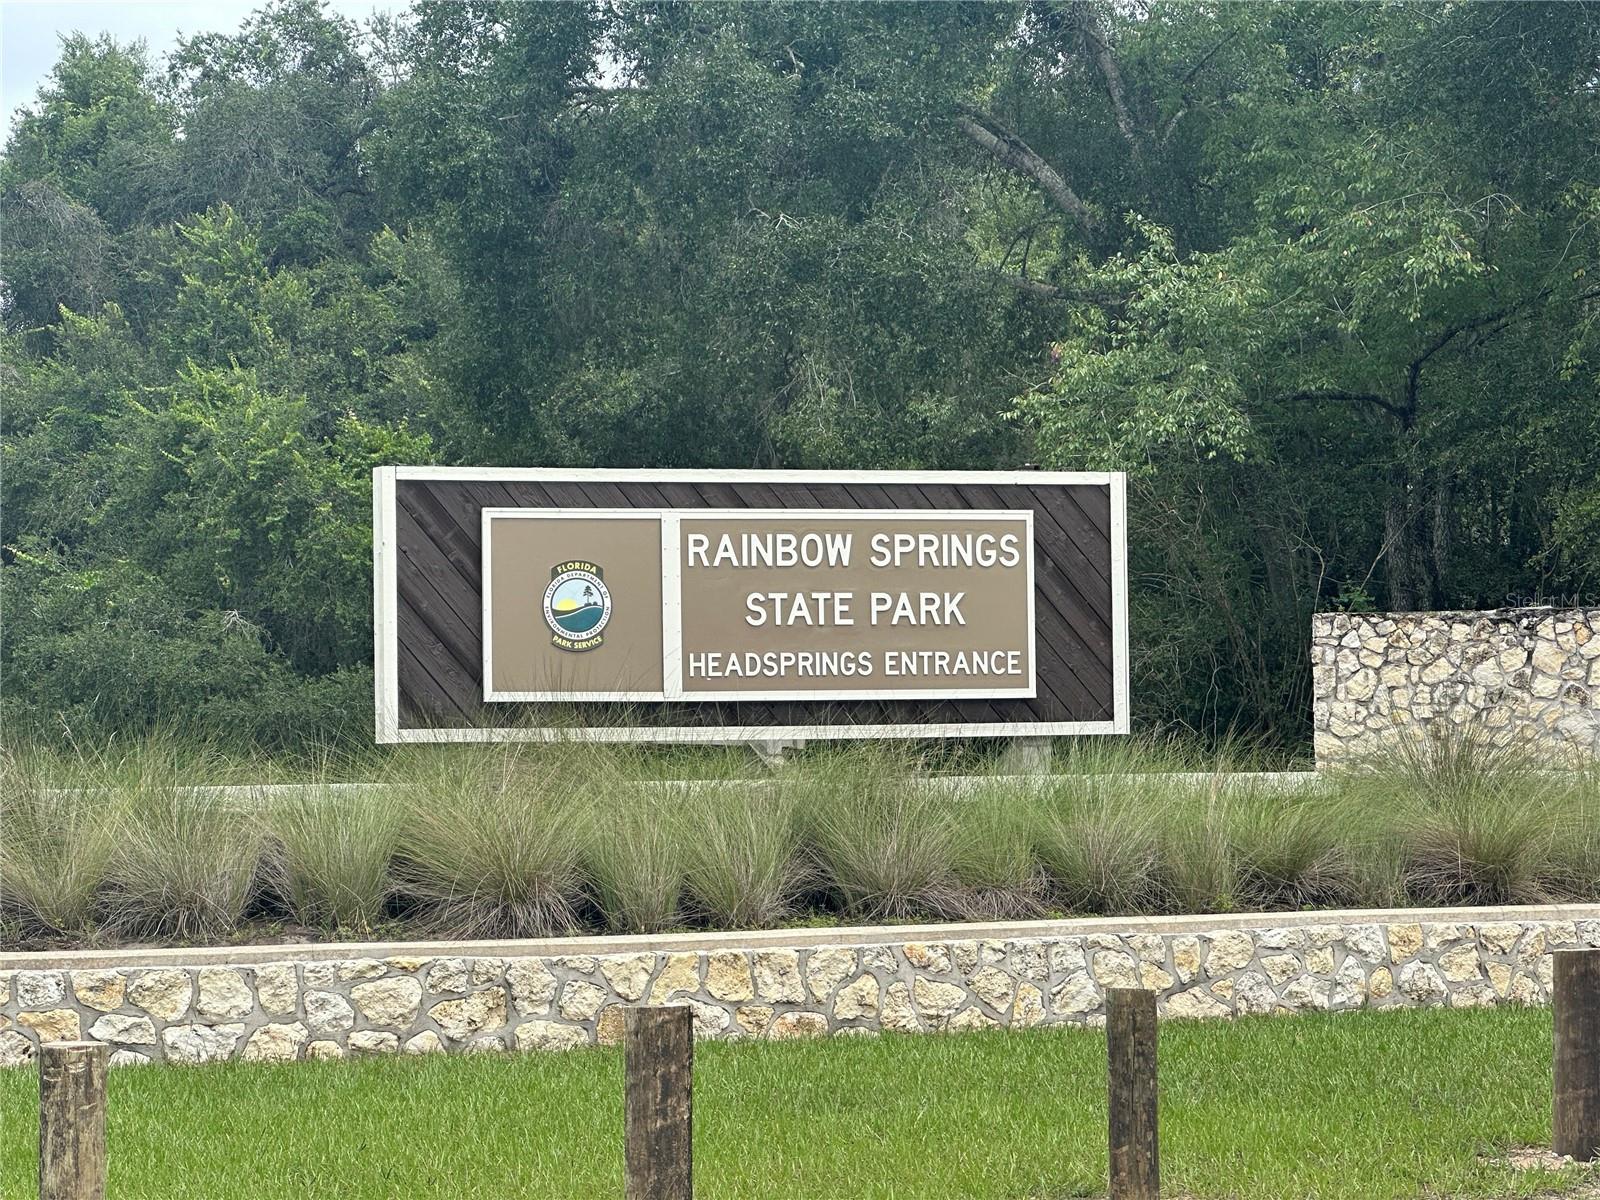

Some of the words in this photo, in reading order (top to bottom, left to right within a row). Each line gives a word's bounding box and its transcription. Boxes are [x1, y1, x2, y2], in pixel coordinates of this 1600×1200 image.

[687, 533, 853, 567] RAINBOW
[870, 533, 1021, 567] SPRINGS
[557, 562, 597, 574] FLORIDA
[745, 592, 854, 626] STATE
[871, 592, 966, 625] PARK
[552, 635, 572, 648] PARK
[574, 635, 603, 648] SERVICE
[689, 652, 873, 677] HEADSPRINGS
[884, 650, 1022, 676] ENTRANCE
